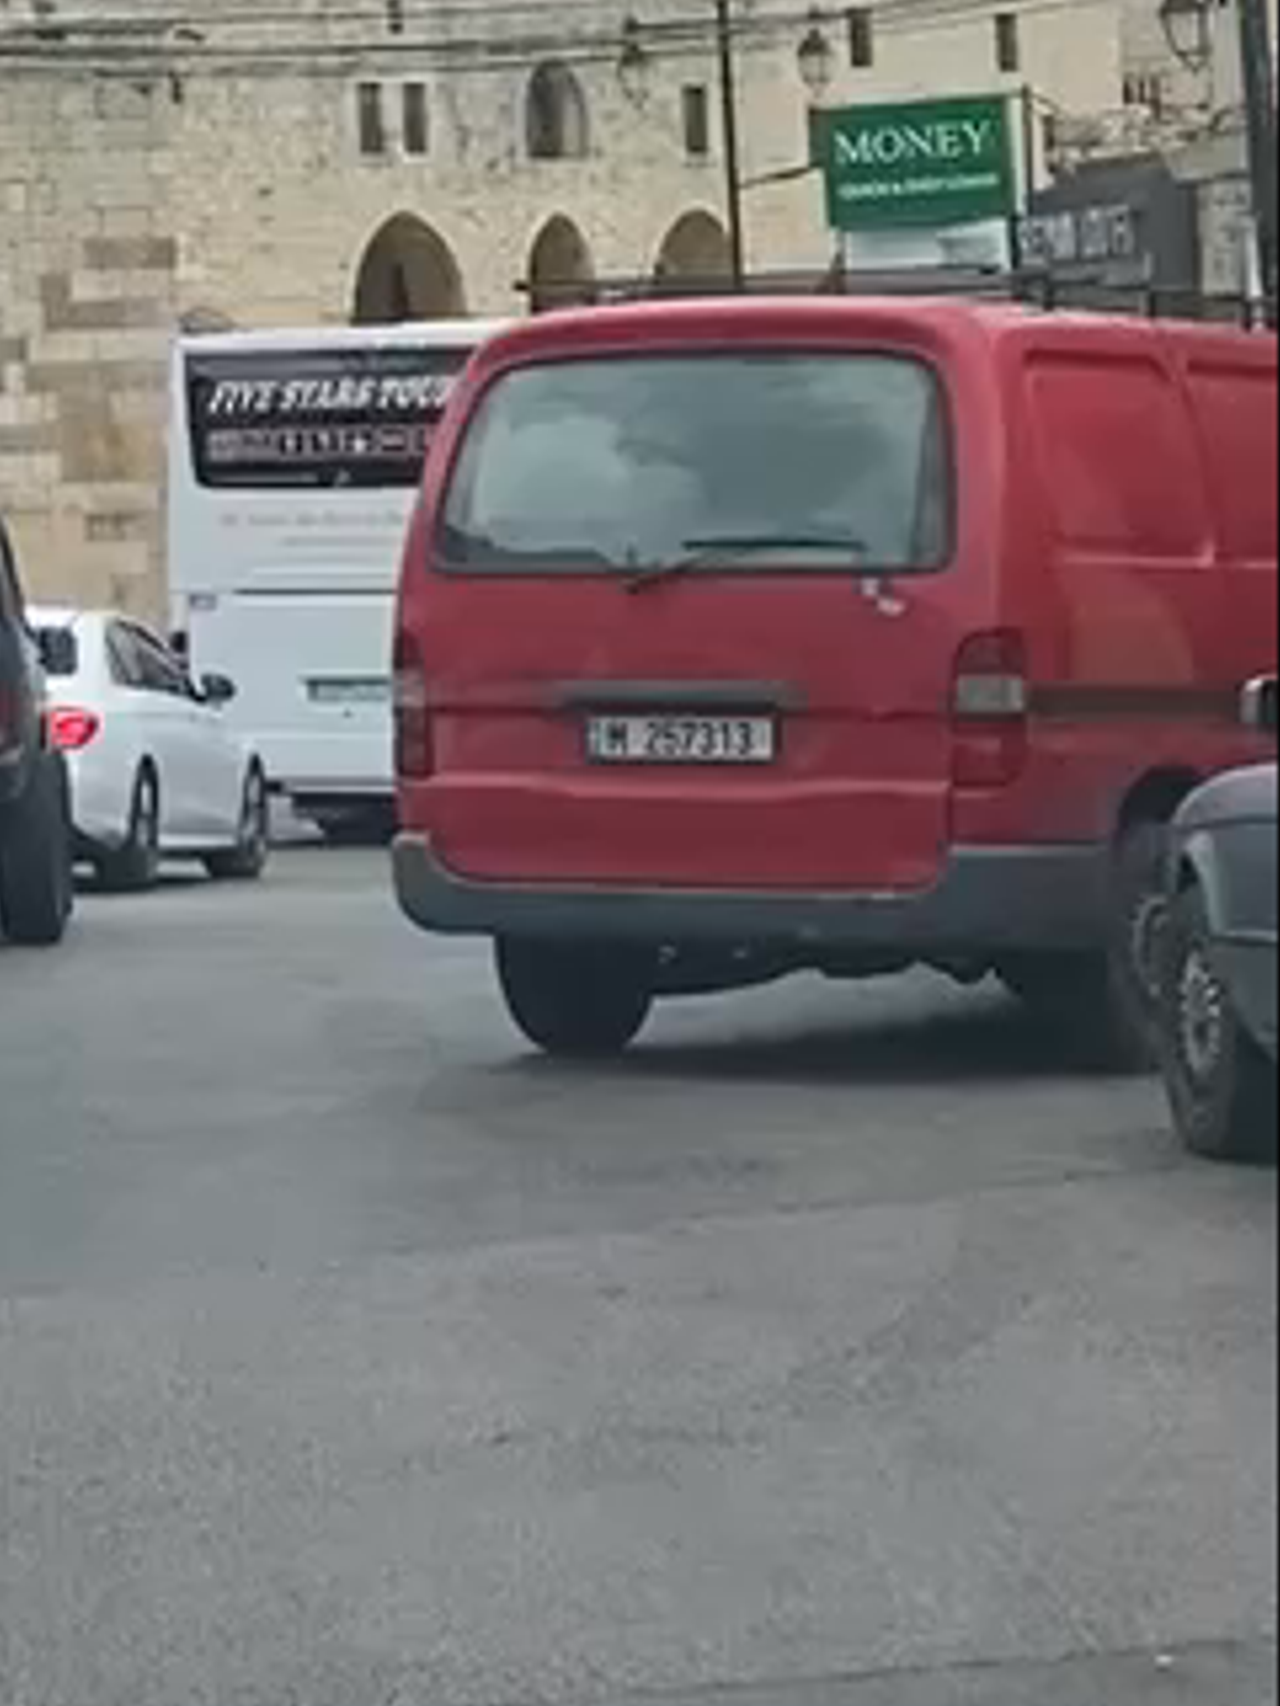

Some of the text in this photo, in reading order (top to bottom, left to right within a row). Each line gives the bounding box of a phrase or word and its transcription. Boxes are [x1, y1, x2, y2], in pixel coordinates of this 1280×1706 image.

[835, 119, 989, 164] MONEY
[208, 380, 278, 414] FIVE
[279, 376, 376, 410] STARS
